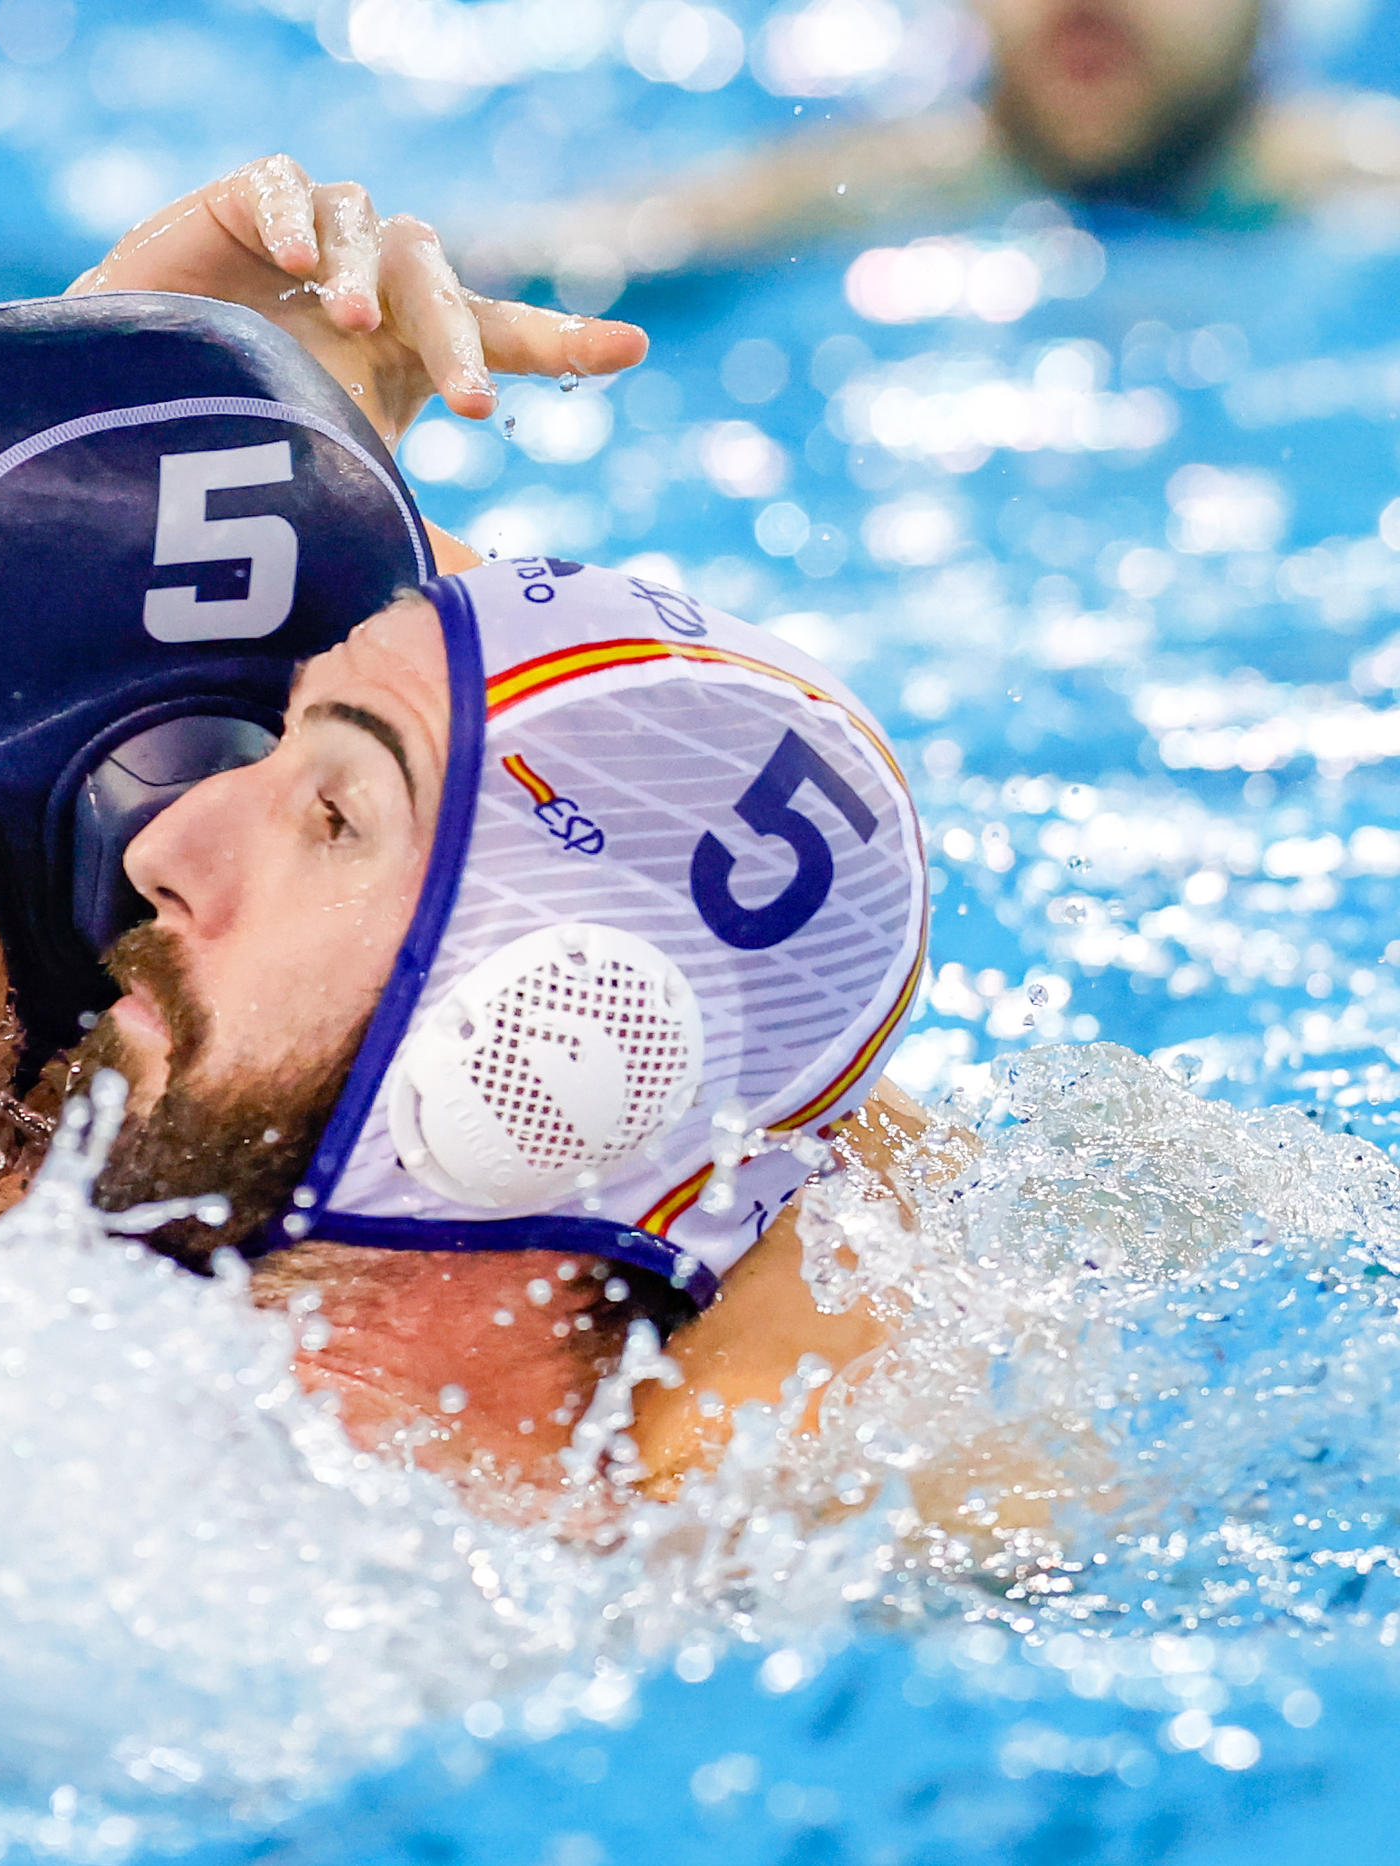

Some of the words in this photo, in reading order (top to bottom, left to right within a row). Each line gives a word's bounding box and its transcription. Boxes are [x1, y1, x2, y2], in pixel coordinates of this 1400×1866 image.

[142, 439, 300, 644] 5
[533, 797, 605, 855] ESP
[689, 728, 879, 950] 5
